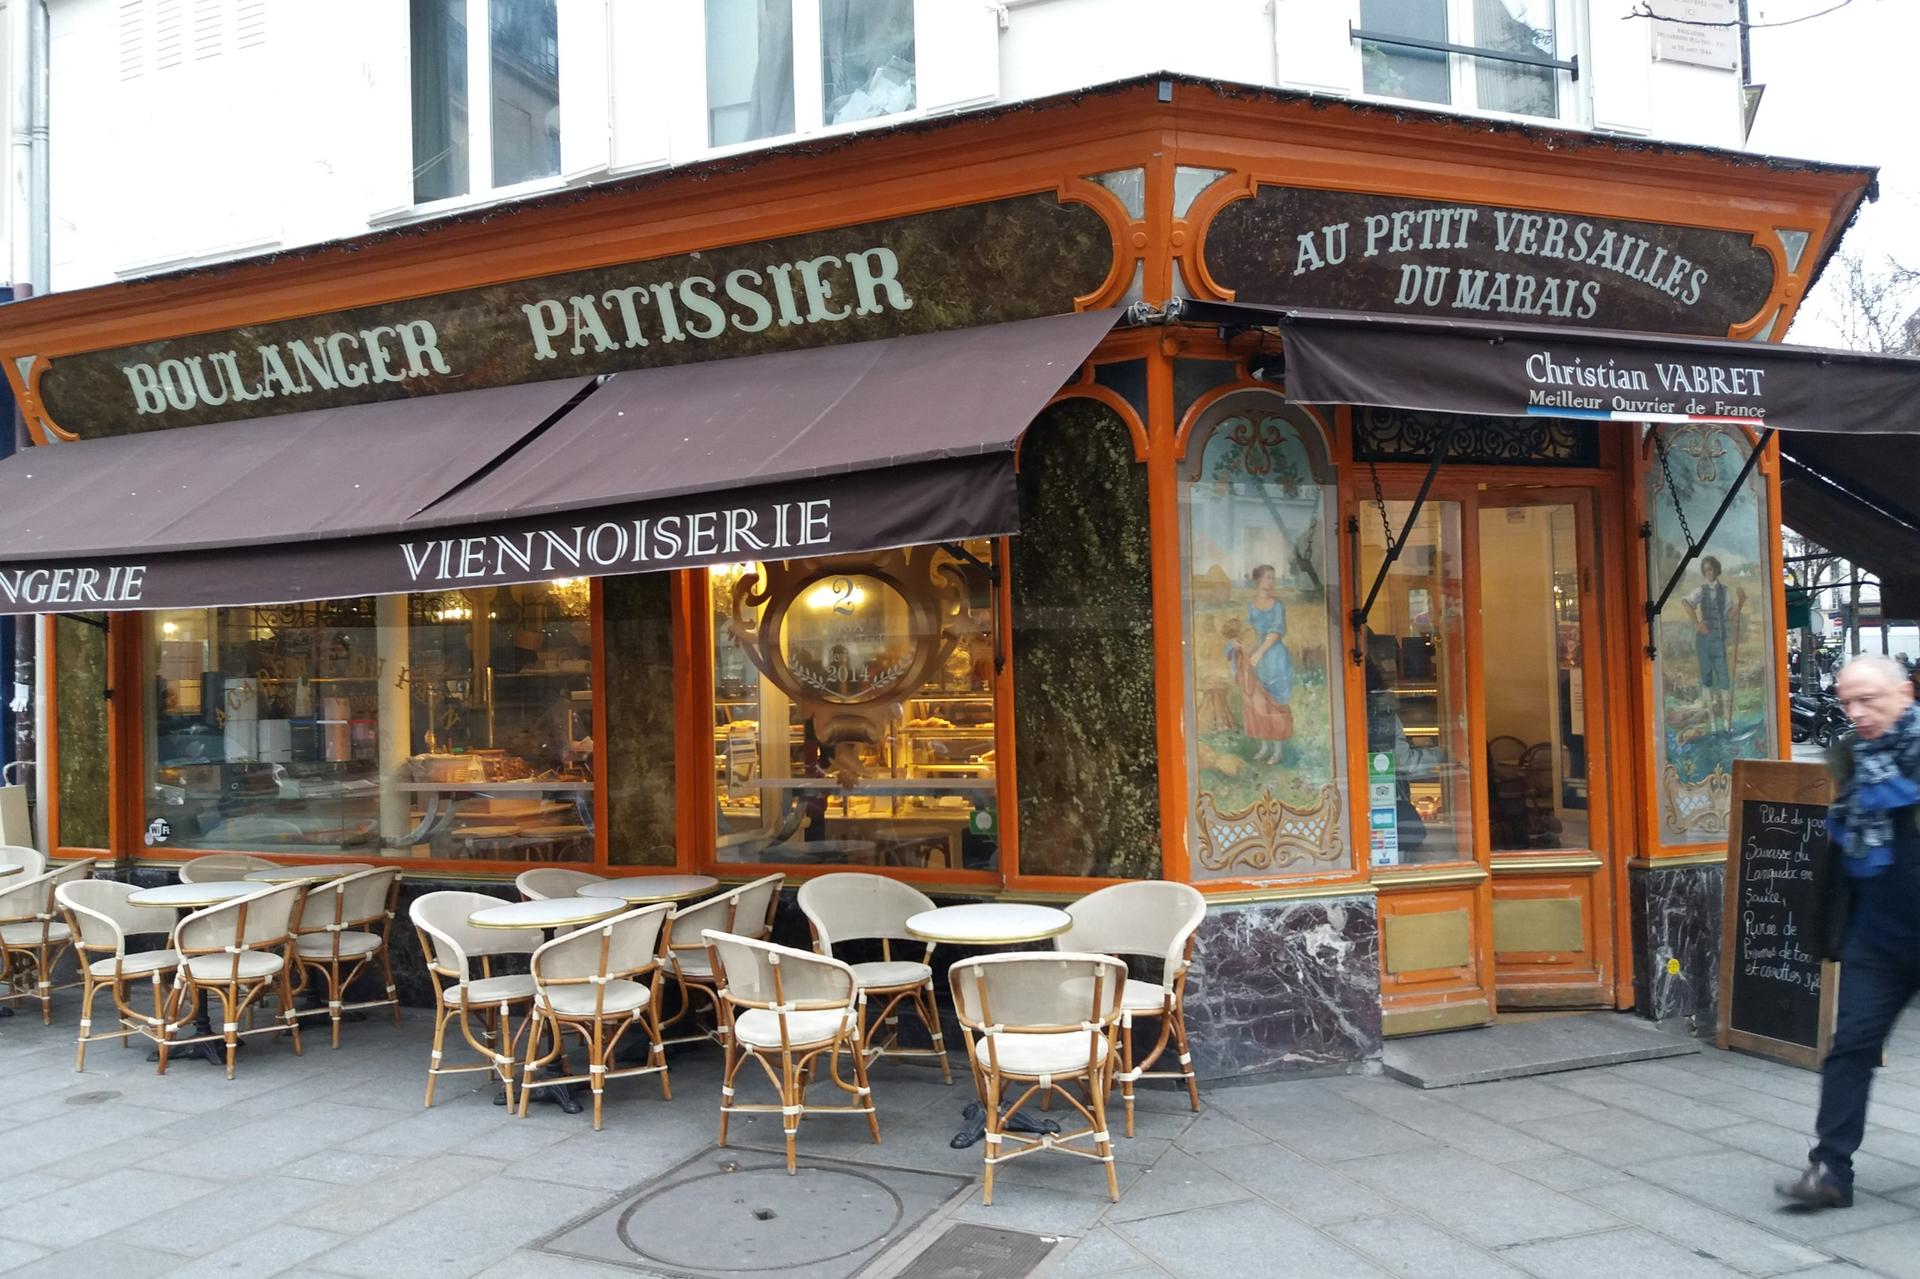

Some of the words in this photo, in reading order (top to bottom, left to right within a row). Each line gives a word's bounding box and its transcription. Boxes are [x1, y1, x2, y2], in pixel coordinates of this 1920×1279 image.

[1293, 222, 1350, 276] AU
[1364, 207, 1478, 257] PETIT
[1493, 210, 1708, 306] VERSAILLES
[1394, 264, 1450, 307] DU
[1452, 269, 1600, 319] MARAIS
[123, 319, 451, 415] BOULANGER
[521, 246, 913, 361] PATISSIER
[1526, 352, 1649, 391] Christian
[1654, 363, 1765, 396] VABRET
[1528, 390, 1604, 409] Meilleur
[1611, 396, 1676, 414] Ouvrier
[1685, 398, 1706, 415] de
[1715, 401, 1766, 418] France
[399, 499, 832, 581] VIENNOISERIE
[826, 664, 870, 682] 2014
[1759, 804, 1788, 824] Plat
[1794, 841, 1811, 863] du
[1783, 911, 1798, 936] de
